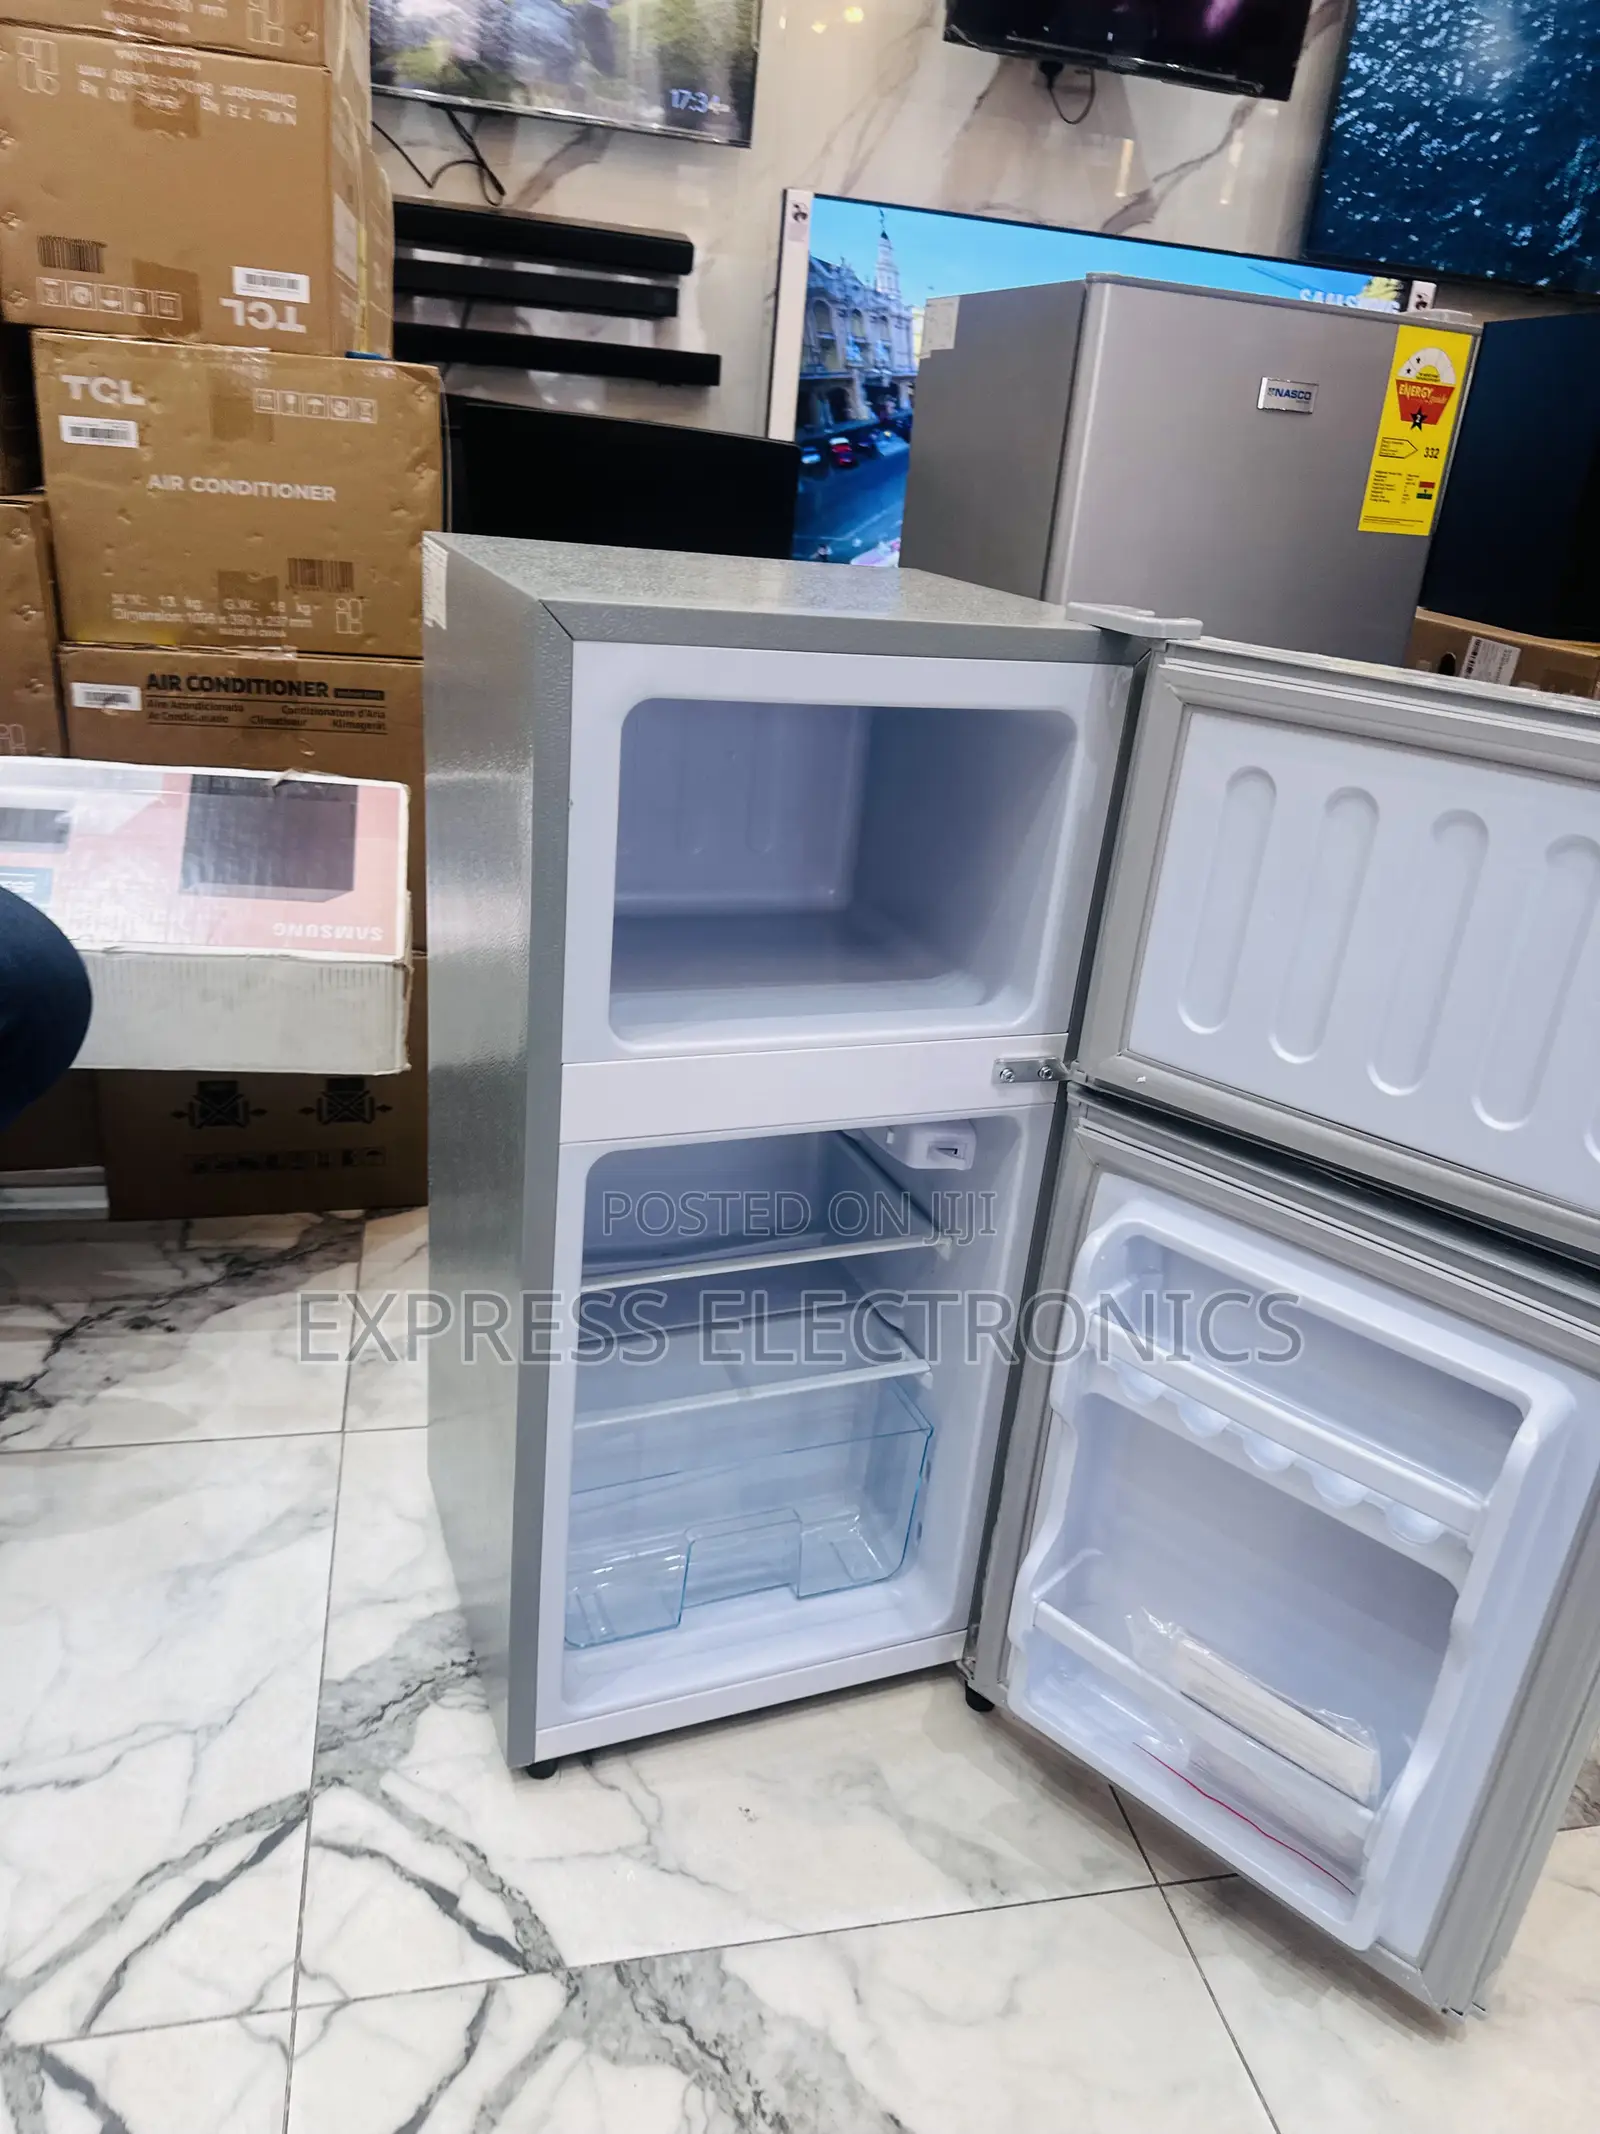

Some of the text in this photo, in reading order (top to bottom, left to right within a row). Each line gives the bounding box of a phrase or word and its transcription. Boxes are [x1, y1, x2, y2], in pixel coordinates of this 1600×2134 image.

[219, 298, 307, 333] TCL
[60, 374, 147, 406] TCL
[1275, 387, 1312, 400] NASCO
[1398, 383, 1434, 400] ENERGY
[1423, 447, 1440, 459] 332
[147, 474, 337, 502] AIR CONDITIONER
[146, 673, 183, 692] AIR
[186, 675, 329, 698] CONDITIONER
[272, 921, 384, 942] SAMSUNG
